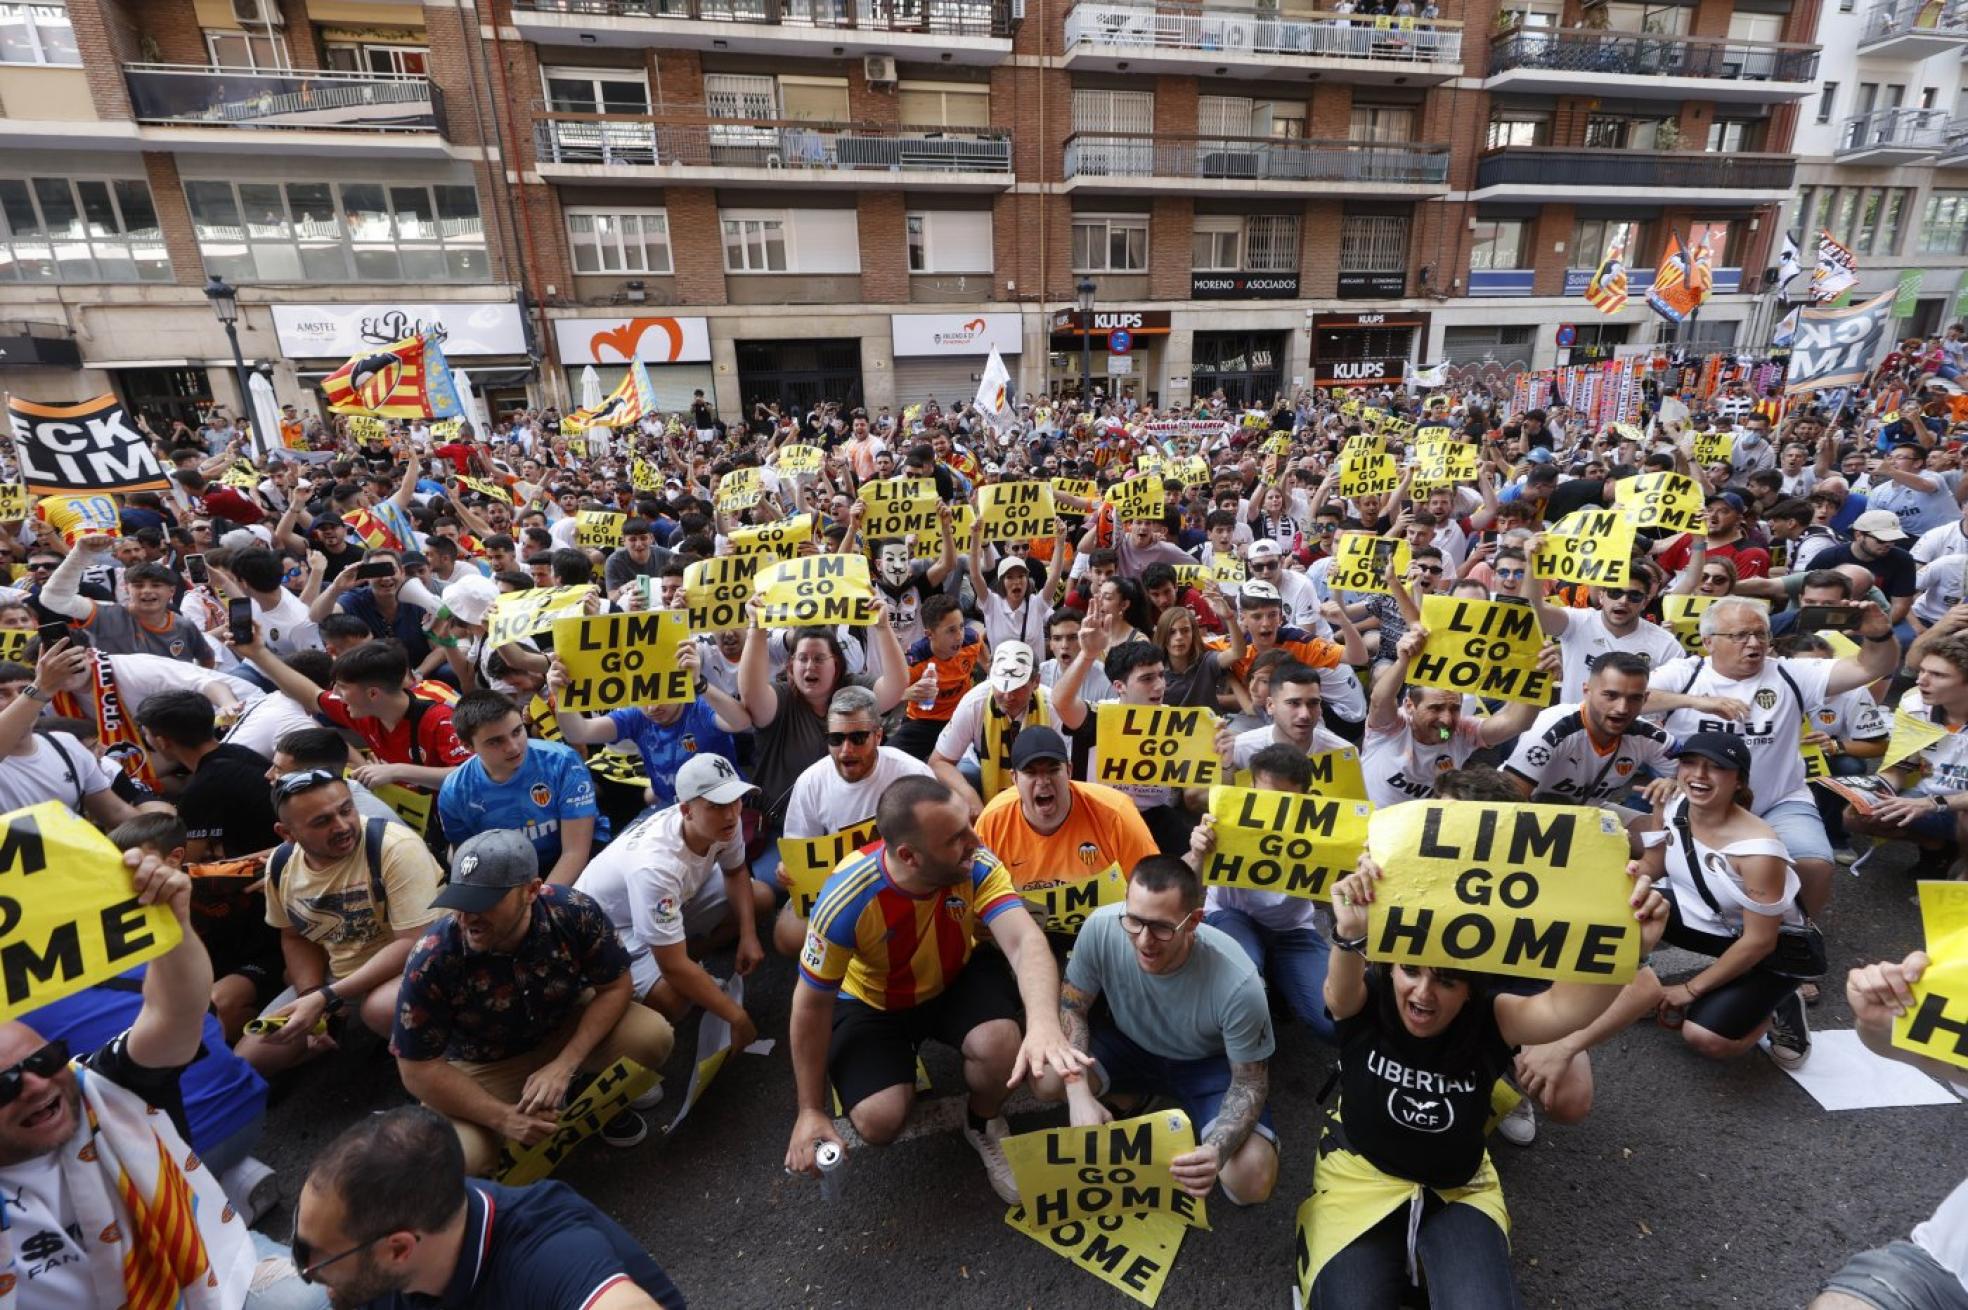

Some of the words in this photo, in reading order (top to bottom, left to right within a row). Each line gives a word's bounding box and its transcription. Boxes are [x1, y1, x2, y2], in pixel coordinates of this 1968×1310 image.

[1194, 280, 1234, 289] MORENO
[1247, 279, 1297, 289] ASOCIADOS
[296, 322, 336, 332] AMSTEL
[1095, 314, 1142, 328] KUUPS
[1358, 315, 1385, 324] KUUPS
[1333, 362, 1385, 379] KUUPS
[1424, 427, 1445, 435] LIM
[787, 446, 812, 457] LIM
[1347, 436, 1378, 449] LIM
[1428, 443, 1463, 457] LIM
[17, 441, 161, 484] LIM
[793, 457, 806, 466] GO
[1350, 455, 1385, 472] LIM
[1436, 456, 1456, 465] GO
[1697, 454, 1731, 465] OME
[722, 471, 749, 488] LIM
[1358, 471, 1377, 479] GO
[1416, 467, 1474, 478] HOME
[730, 485, 746, 494] GO
[875, 482, 920, 501] LIM
[993, 484, 1040, 505] LIM
[1058, 480, 1089, 493] LIM
[1111, 478, 1148, 500] LIM
[1343, 478, 1397, 496] HOME
[1634, 475, 1692, 496] LIM
[720, 492, 761, 512] HOME
[888, 500, 913, 514] GO
[1122, 496, 1142, 509] GO
[1645, 492, 1677, 505] GO
[68, 495, 117, 522] 10
[1004, 505, 1031, 518] GO
[1121, 502, 1162, 518] OME
[1896, 506, 1921, 518] win
[586, 512, 616, 526] LIM
[866, 512, 936, 535] HOME
[1551, 512, 1616, 538] LIM
[1638, 506, 1702, 530] OME
[592, 526, 609, 535] GO
[757, 530, 784, 542] GO
[983, 518, 1054, 539] HOME
[580, 534, 625, 547] HOME
[1565, 538, 1598, 555] GO
[700, 556, 757, 586] LIM
[777, 556, 845, 582] LIM
[1177, 567, 1200, 580] IM
[1537, 554, 1624, 583] HOME
[715, 584, 747, 600] GO
[796, 579, 835, 597] GO
[764, 597, 870, 623] HOME
[1448, 602, 1535, 642] LIM
[579, 615, 660, 651] LIM
[1464, 637, 1511, 662] GO
[601, 650, 645, 673] GO
[1413, 653, 1549, 699] HOME
[563, 670, 688, 708] HOME
[1122, 709, 1200, 737] LIM
[1698, 720, 1774, 736] BLU
[1138, 738, 1179, 757] GO
[1102, 758, 1217, 784] HOME
[1238, 792, 1341, 837] LIM
[1259, 834, 1313, 860] GO
[1419, 807, 1577, 869] LIM
[1455, 867, 1539, 909] GO
[1046, 879, 1099, 916] IM
[1378, 905, 1627, 975] HOME
[1367, 1050, 1478, 1094] LIBERTAD
[1402, 1109, 1440, 1127] VCF
[1047, 1122, 1152, 1166] LIM
[1077, 1167, 1136, 1184] GO
[1036, 1186, 1197, 1226] HOME
[1050, 1218, 1162, 1292] OME
[28, 1252, 80, 1281] FAN
